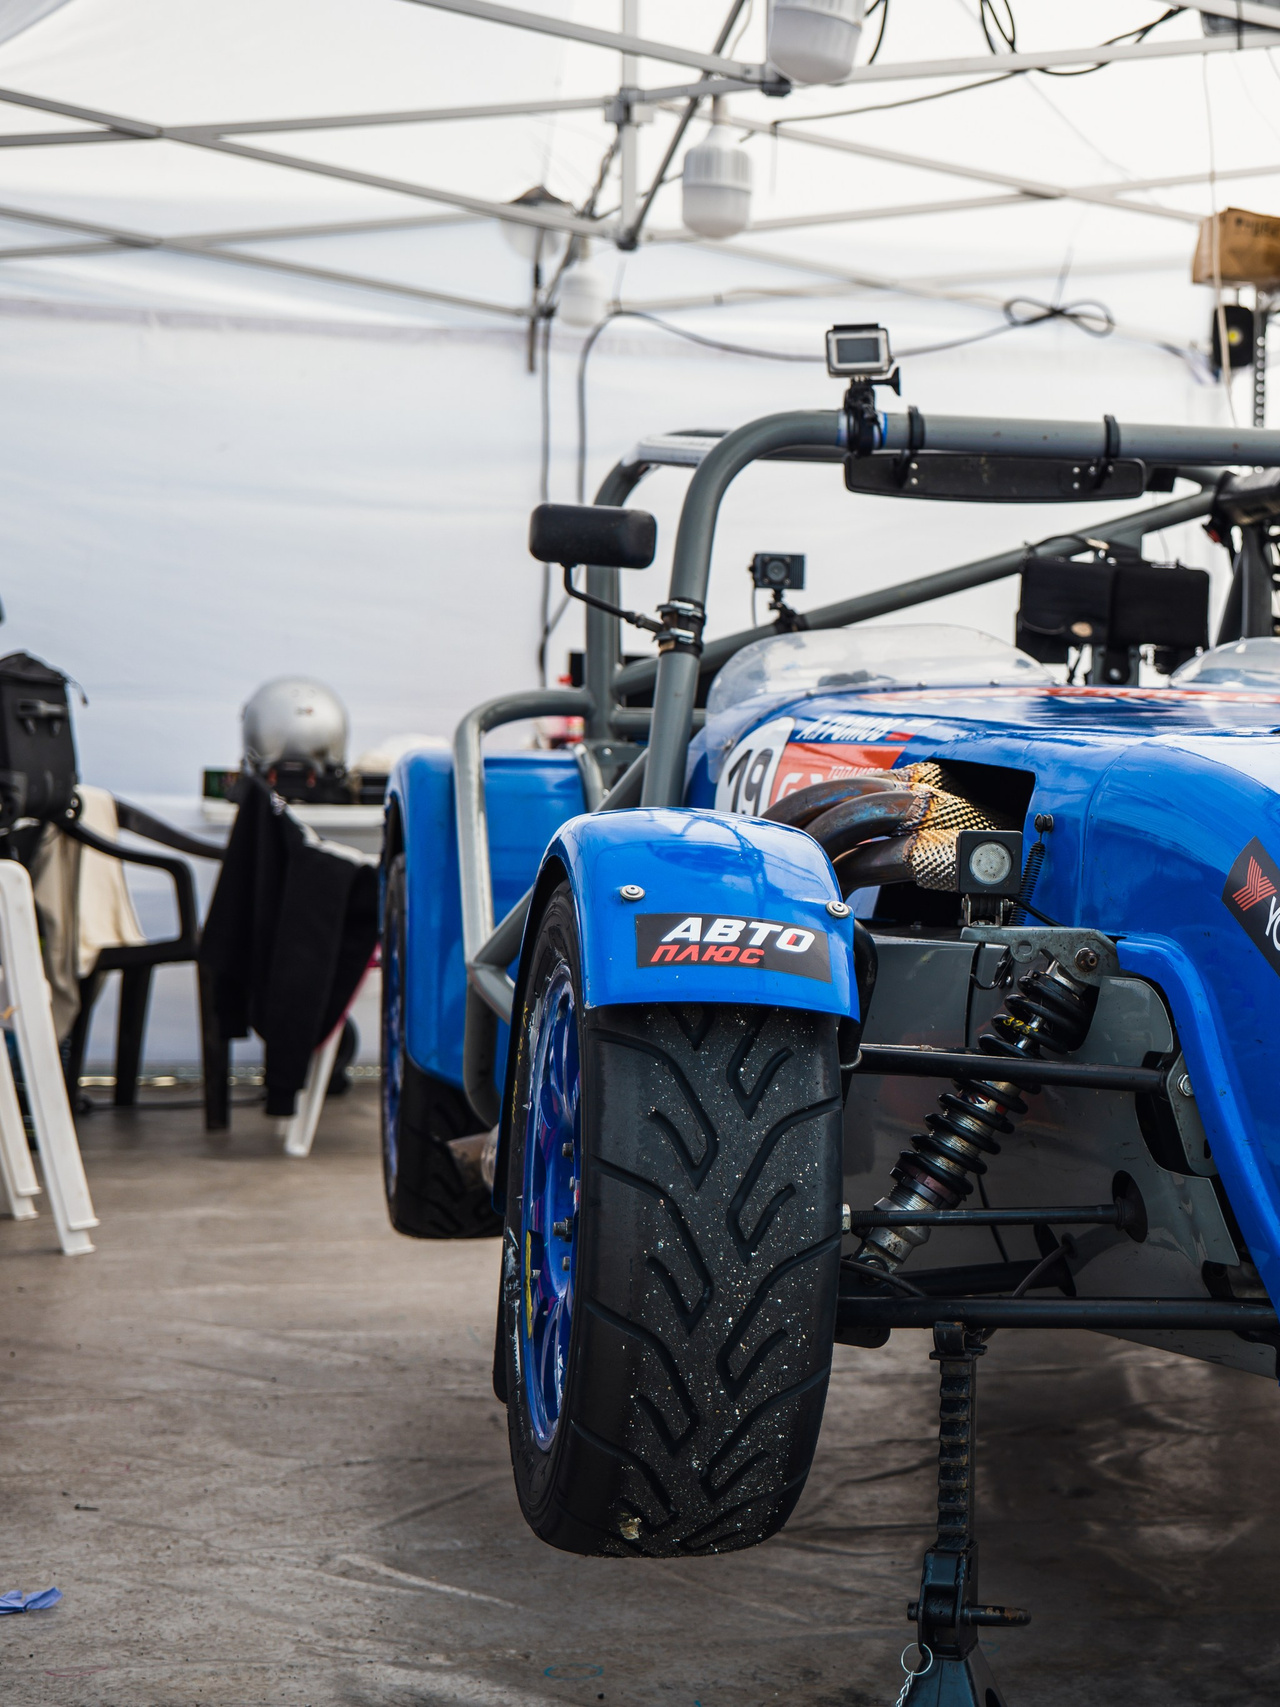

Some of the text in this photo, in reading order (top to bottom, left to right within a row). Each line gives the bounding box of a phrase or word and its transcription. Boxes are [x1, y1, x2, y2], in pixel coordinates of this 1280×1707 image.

[728, 748, 774, 817] 19
[660, 916, 816, 953] АВТО
[650, 944, 765, 964] ПЛЮС
